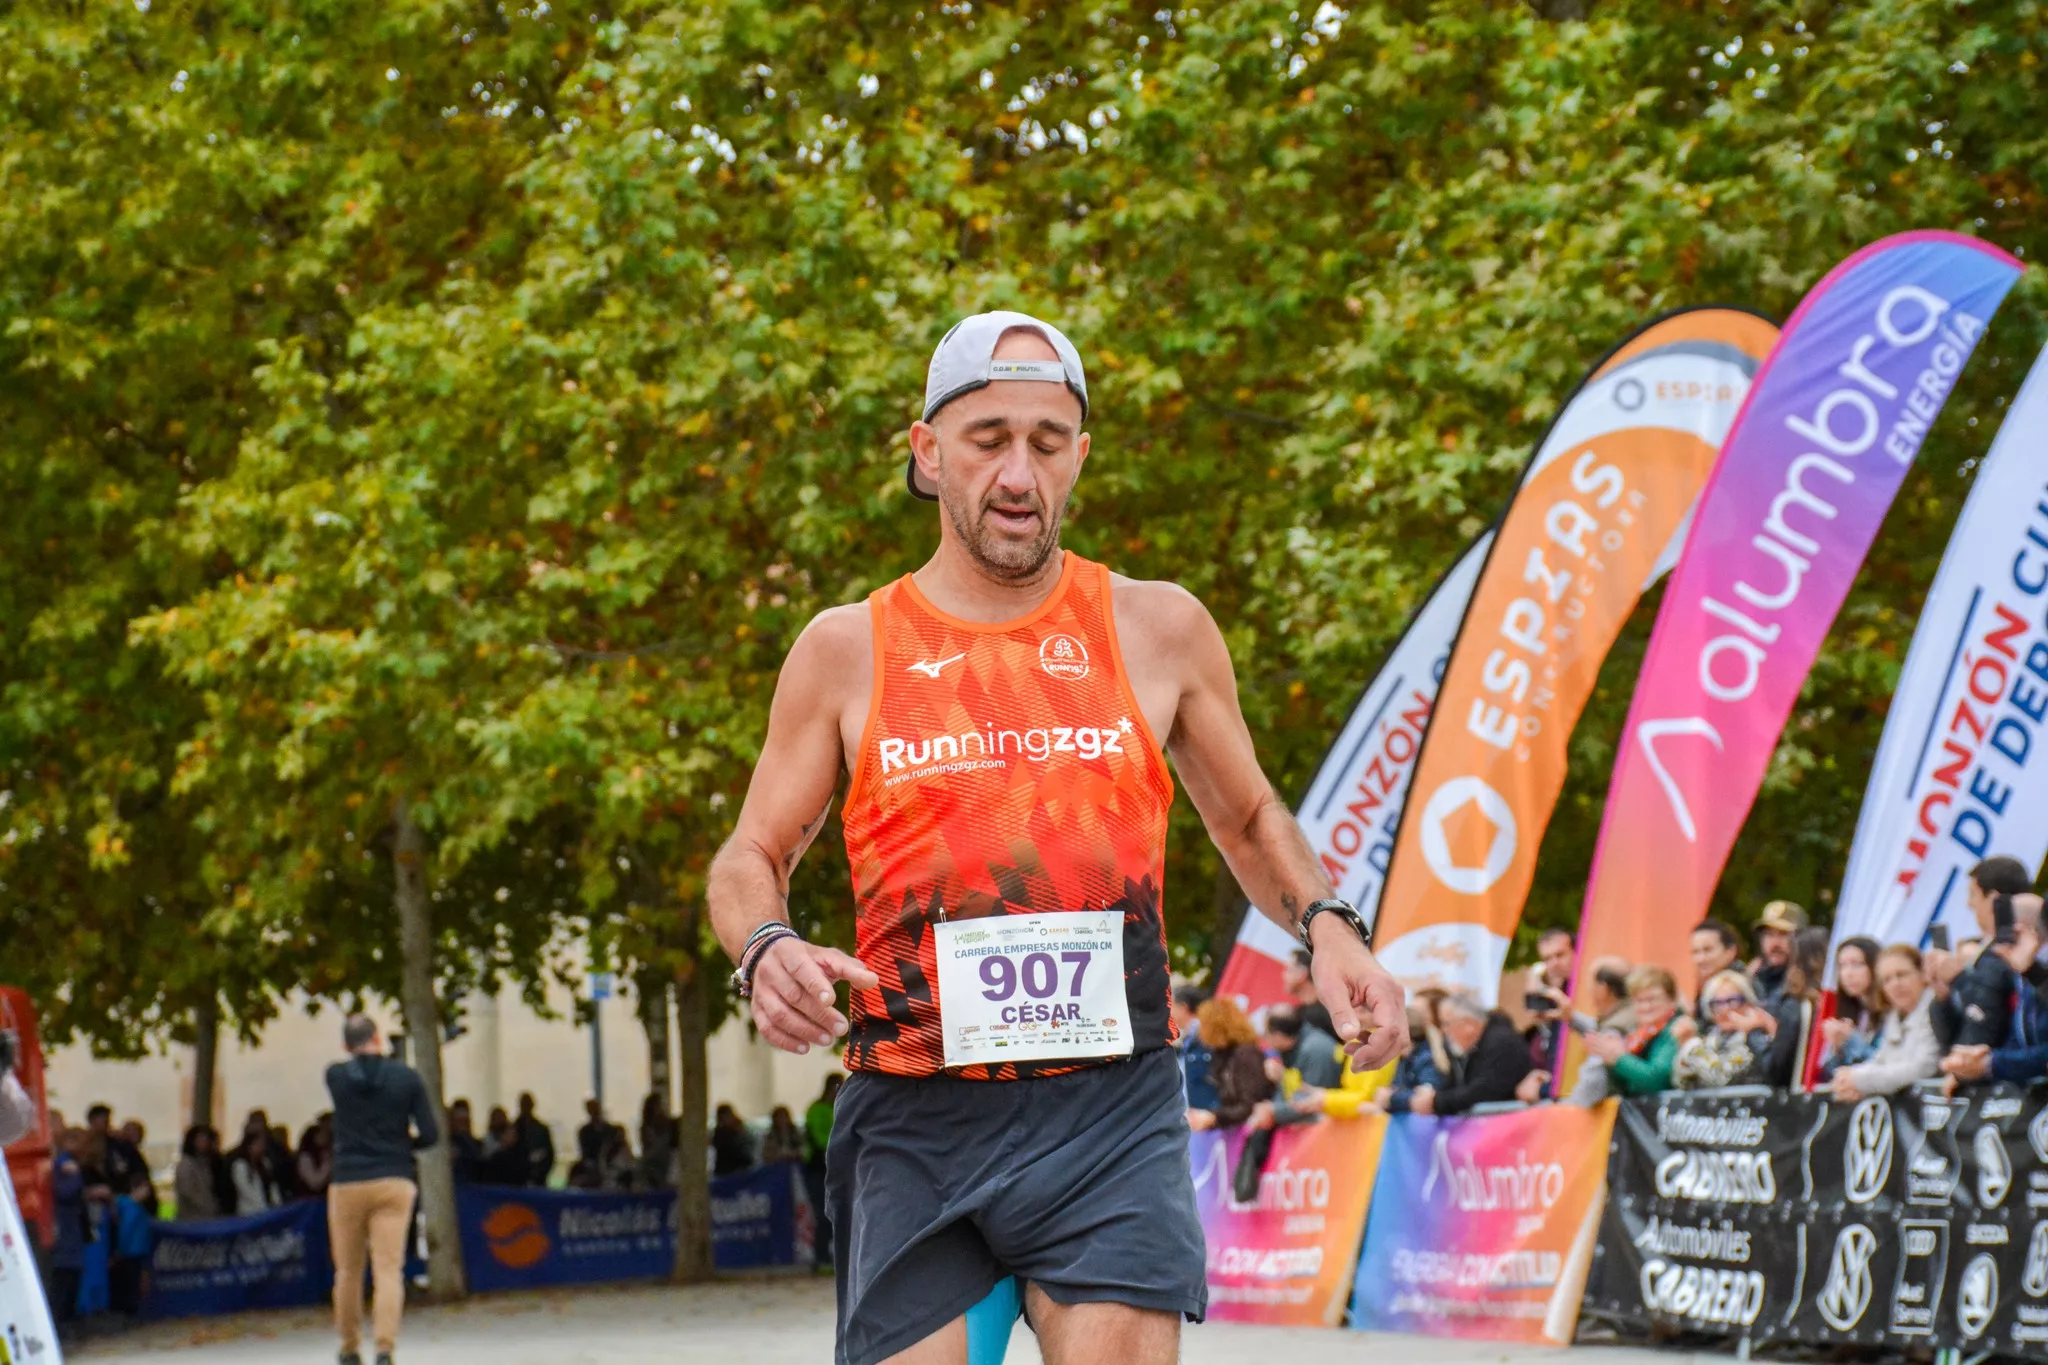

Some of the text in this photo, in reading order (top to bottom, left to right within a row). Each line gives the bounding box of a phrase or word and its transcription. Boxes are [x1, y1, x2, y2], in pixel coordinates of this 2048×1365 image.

[1884, 312, 1983, 464] ENERGÍA
[1700, 284, 1951, 701] alumbra
[1467, 450, 1624, 750] ESPIAS
[884, 758, 1006, 787] www.runningzgz.com
[1951, 764, 2014, 861] DE
[954, 940, 1113, 959] CARRERA EMPRESAS MONZÓN CM
[978, 951, 1092, 1002] 907
[1001, 1001, 1081, 1024] CÉSAR
[1640, 1259, 1766, 1326] CABRERO
